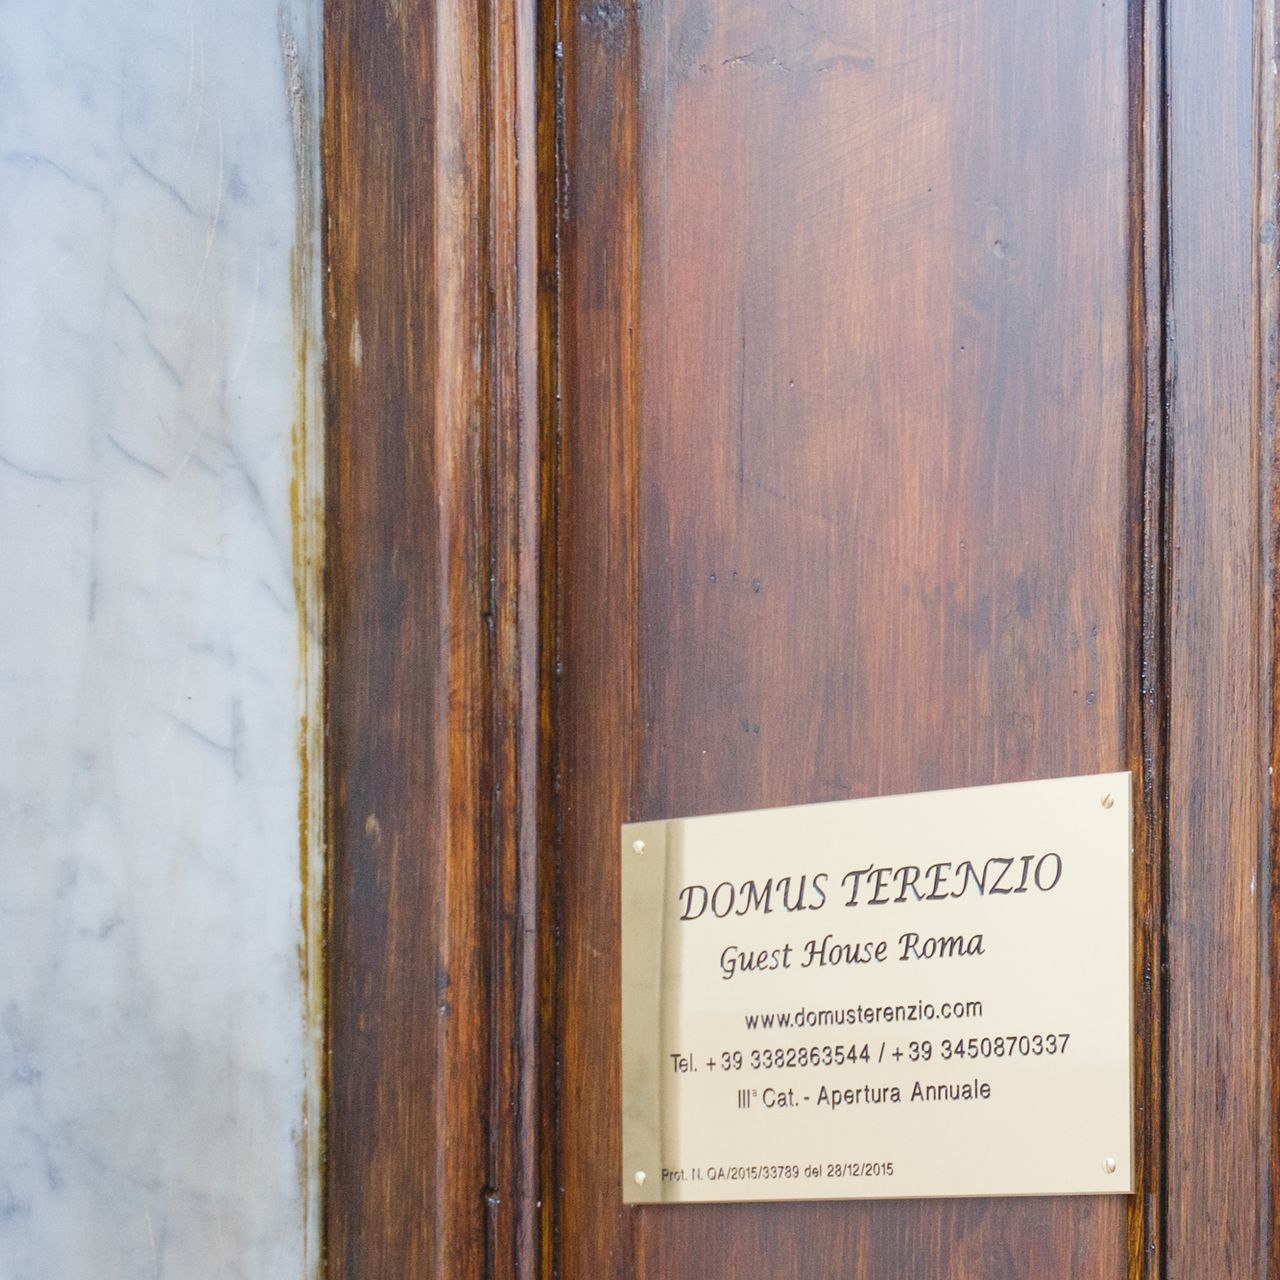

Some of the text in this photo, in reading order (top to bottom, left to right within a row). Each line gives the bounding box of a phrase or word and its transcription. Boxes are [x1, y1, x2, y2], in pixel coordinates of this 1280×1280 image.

[679, 852, 1063, 921] DOMUS TERENZIO
[720, 932, 986, 980] Guest House Roma
[745, 1000, 983, 1030] www.domusterenzio.com
[670, 1053, 698, 1073] Tel.
[750, 1044, 871, 1070] 3382863544
[940, 1033, 1071, 1060] 3450870337
[762, 1087, 799, 1108] Cat.
[817, 1083, 902, 1110] Apertura
[910, 1078, 992, 1103] Annuale
[661, 1167, 688, 1182] Prot.
[804, 1164, 823, 1178] del
[826, 1162, 894, 1178] 28/12/2015
